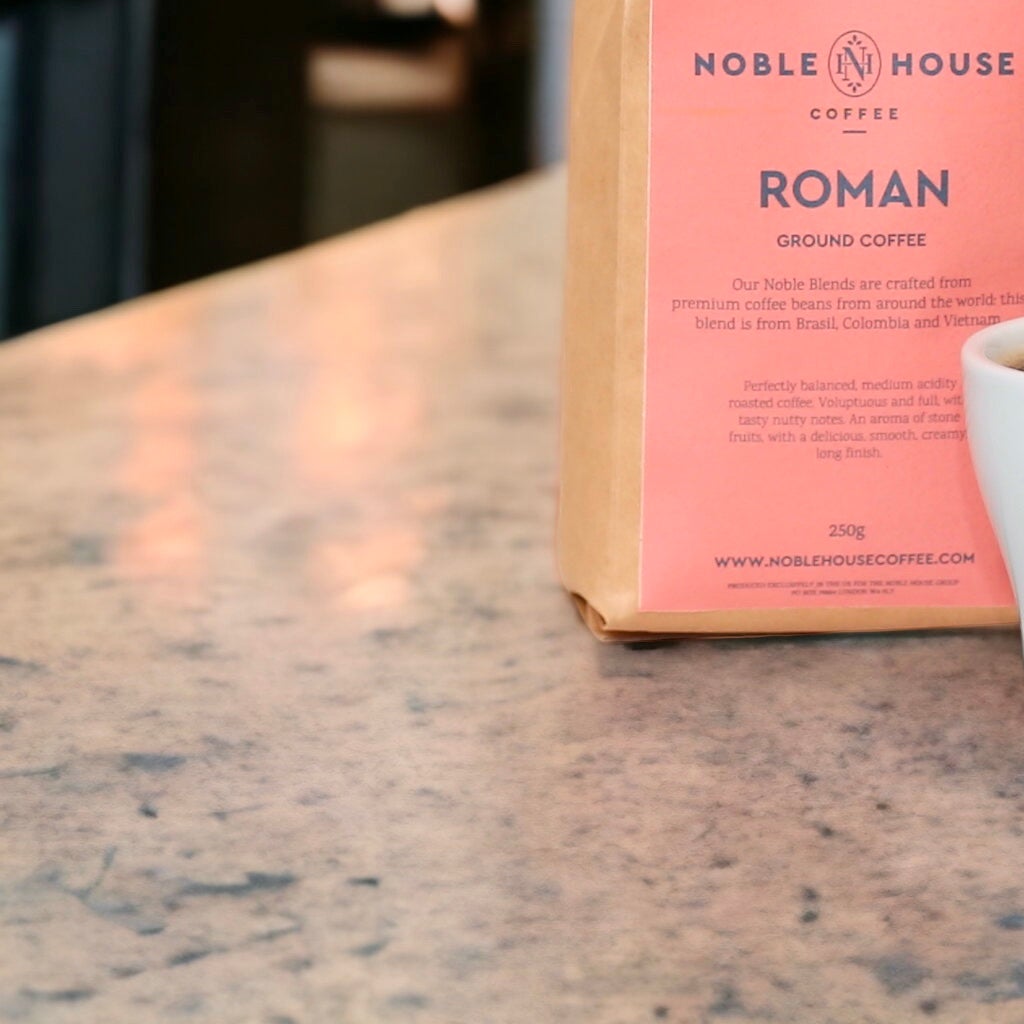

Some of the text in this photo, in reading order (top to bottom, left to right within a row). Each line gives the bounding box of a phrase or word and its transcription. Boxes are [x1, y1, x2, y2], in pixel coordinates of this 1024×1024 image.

[694, 52, 818, 77] NOBLE
[891, 52, 1015, 76] HOUSE
[809, 107, 899, 121] COFFEE
[759, 169, 949, 209] ROMAN
[776, 232, 927, 248] GROUND COFFEE
[732, 276, 972, 292] Our Noble Blends are crafted from
[672, 297, 740, 312] premium
[745, 297, 787, 311] coffee
[791, 297, 832, 311] beans
[837, 295, 871, 310] from
[876, 295, 926, 309] around
[931, 294, 953, 308] the
[695, 313, 1001, 331] blend is from Brasil, Colombia and Vietnam
[743, 378, 957, 393] Perfectly balanced, medium acidity
[728, 397, 774, 408] roasted
[818, 396, 888, 410] Voluptuous
[891, 396, 914, 407] and
[943, 394, 965, 406] wit
[738, 416, 768, 429] tasty
[772, 415, 806, 427] nutty
[849, 413, 866, 425] An
[870, 414, 910, 424] aroma
[913, 412, 926, 423] of
[927, 412, 960, 423] stone
[728, 431, 764, 443] fruits,
[768, 431, 796, 442] with
[800, 433, 807, 442] a
[816, 447, 883, 462] long finish.
[828, 523, 866, 540] 250g
[714, 552, 975, 568] WWW.NOBLEHOUSECOFFEE.COM
